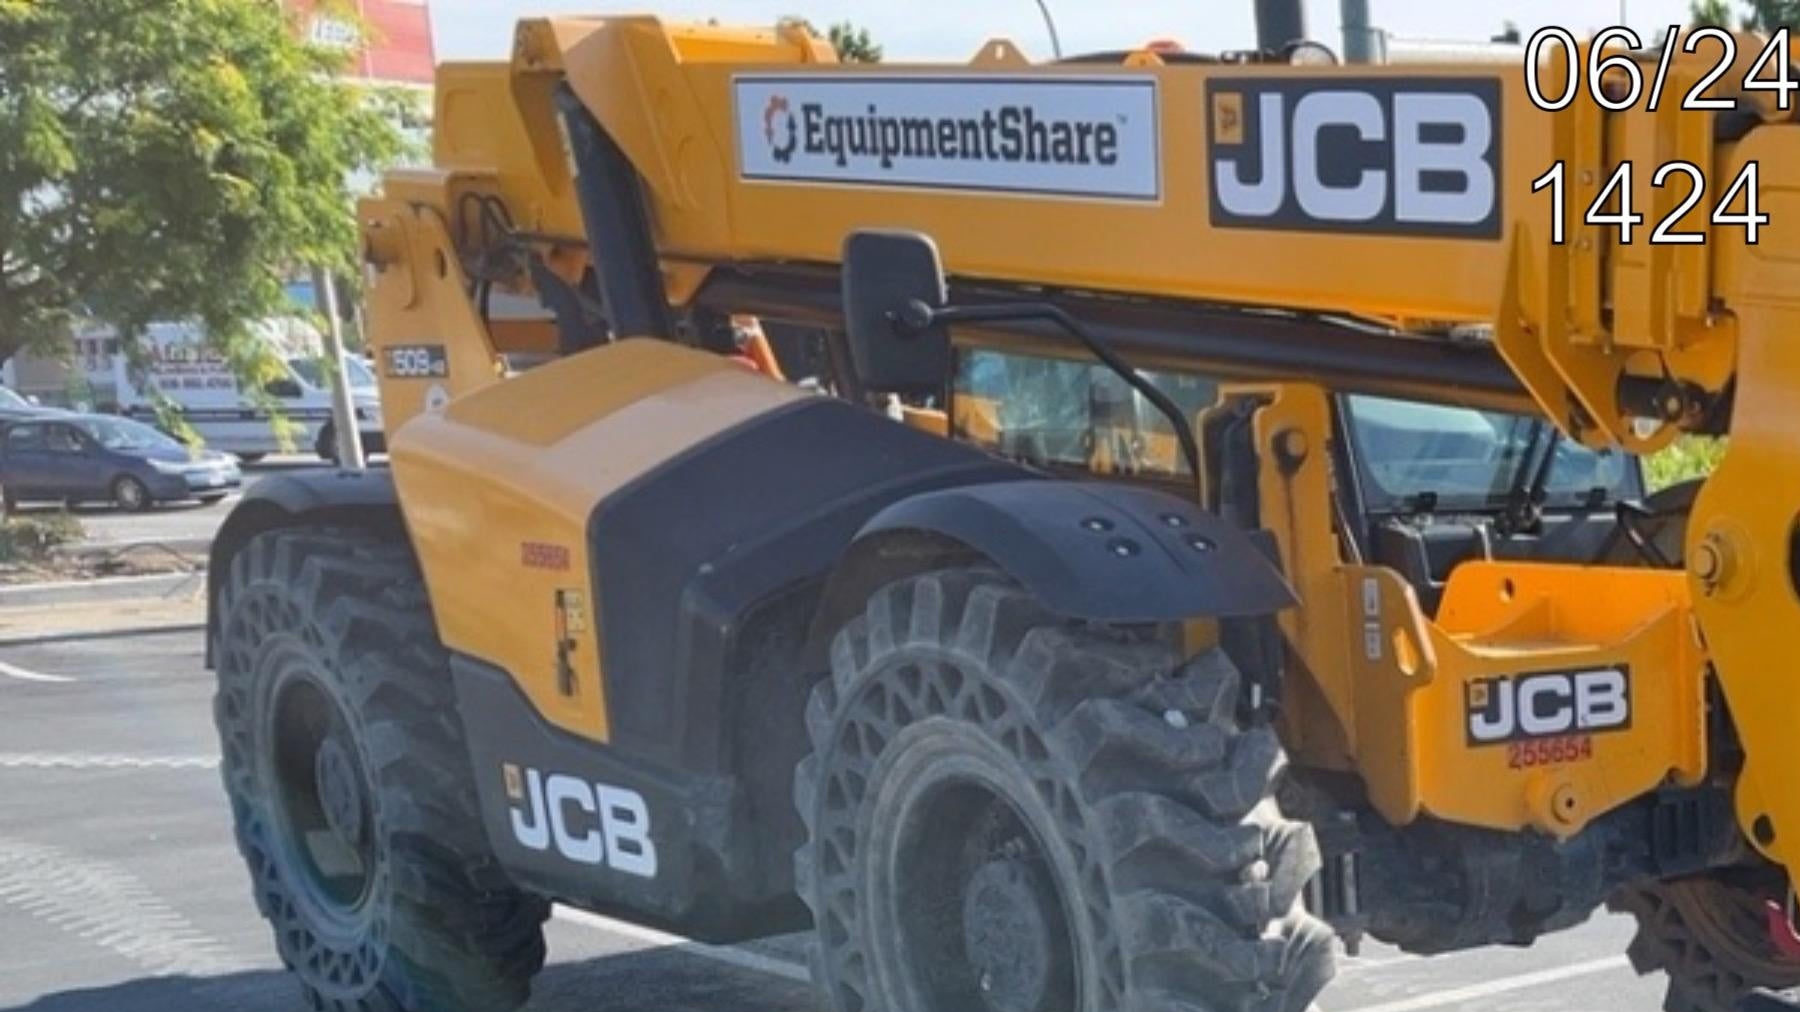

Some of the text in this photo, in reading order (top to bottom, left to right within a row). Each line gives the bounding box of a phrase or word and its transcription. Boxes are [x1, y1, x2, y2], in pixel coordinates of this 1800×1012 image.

[1214, 88, 1496, 224] JCB
[1470, 668, 1629, 740] JCB
[509, 766, 658, 879] JCB
